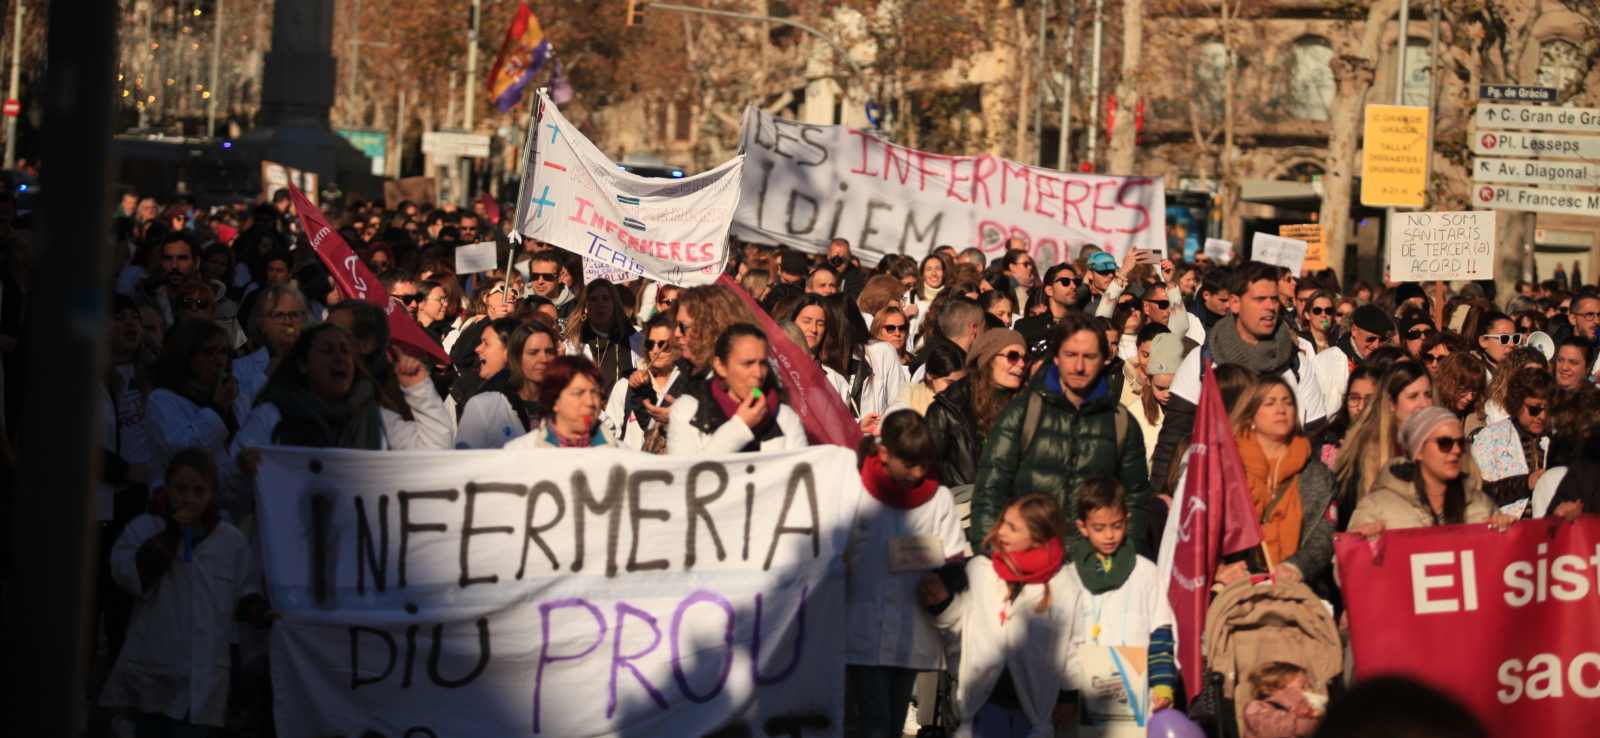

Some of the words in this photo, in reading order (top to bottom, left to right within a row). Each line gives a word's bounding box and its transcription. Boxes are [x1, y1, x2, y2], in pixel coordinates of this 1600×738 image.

[1487, 86, 1502, 98] Pg.
[1504, 87, 1516, 98] de
[1518, 88, 1549, 99] Gràcia
[1500, 108, 1515, 122] C.
[1520, 109, 1553, 123] Gran
[1558, 111, 1575, 125] de
[1380, 143, 1412, 152] TALLAT
[1498, 135, 1516, 150] Pl.
[1521, 136, 1580, 153] Lesseps
[754, 110, 828, 167] LES
[848, 129, 1154, 234] INFERMERES
[1498, 162, 1520, 175] Av.
[1524, 163, 1587, 180] Diagonal
[1496, 188, 1513, 203] Pl.
[1518, 190, 1582, 207] Francesc
[1408, 213, 1432, 226] NO
[1441, 213, 1477, 227] SOM
[568, 196, 715, 263] INFERMERES
[1403, 226, 1481, 242] SANITARiS
[1401, 243, 1417, 257] DE
[1411, 258, 1462, 273] ACORD
[307, 460, 821, 611] iNFERMERiA
[1410, 549, 1479, 615] El
[349, 603, 491, 690] DiU
[532, 585, 810, 734] PROU
[1497, 652, 1600, 705] sac
